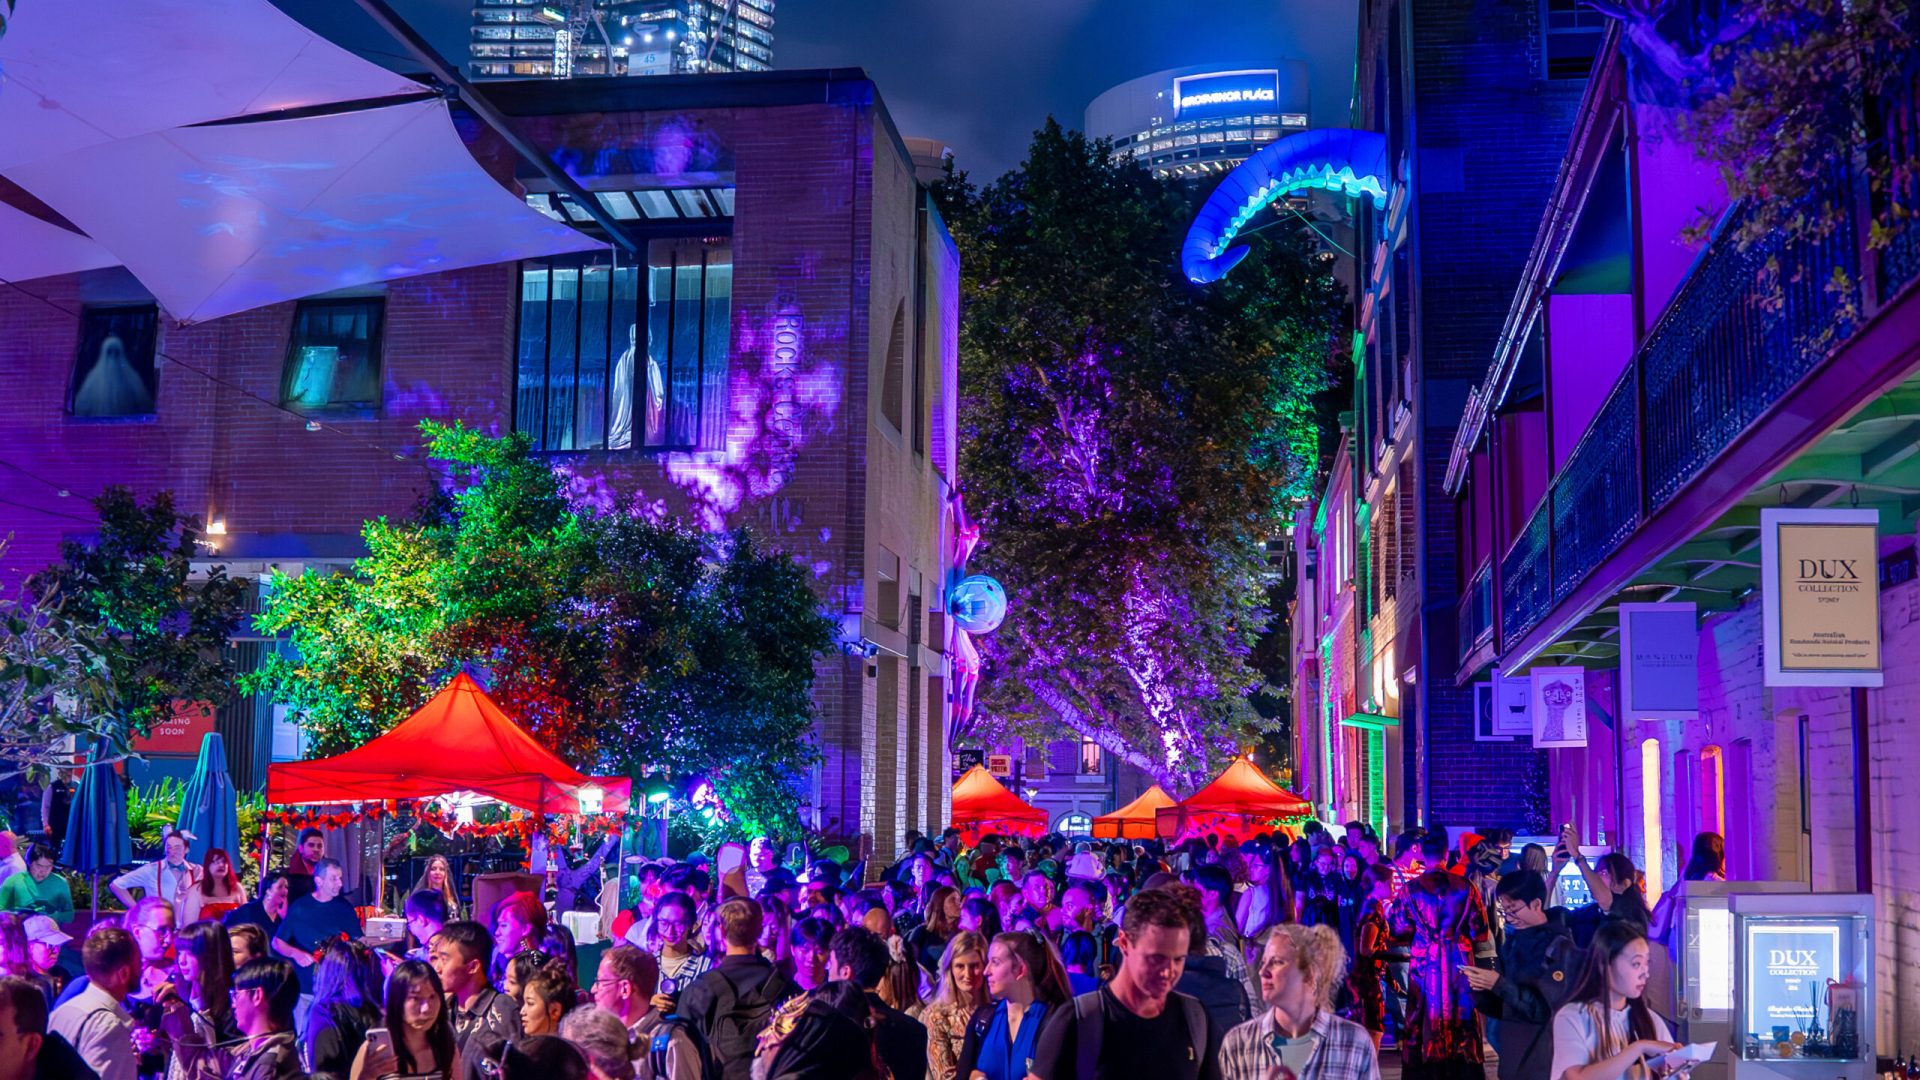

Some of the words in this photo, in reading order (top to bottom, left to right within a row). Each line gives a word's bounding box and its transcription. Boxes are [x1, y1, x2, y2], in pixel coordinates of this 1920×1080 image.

[1181, 91, 1242, 108] GROSVENOR
[1242, 88, 1275, 101] PLACE
[1798, 559, 1859, 579] DUX
[1798, 584, 1859, 593] COLLECTION
[160, 727, 185, 735] SOON
[1769, 949, 1818, 966] DUX
[1769, 969, 1818, 977] COLLECTION
